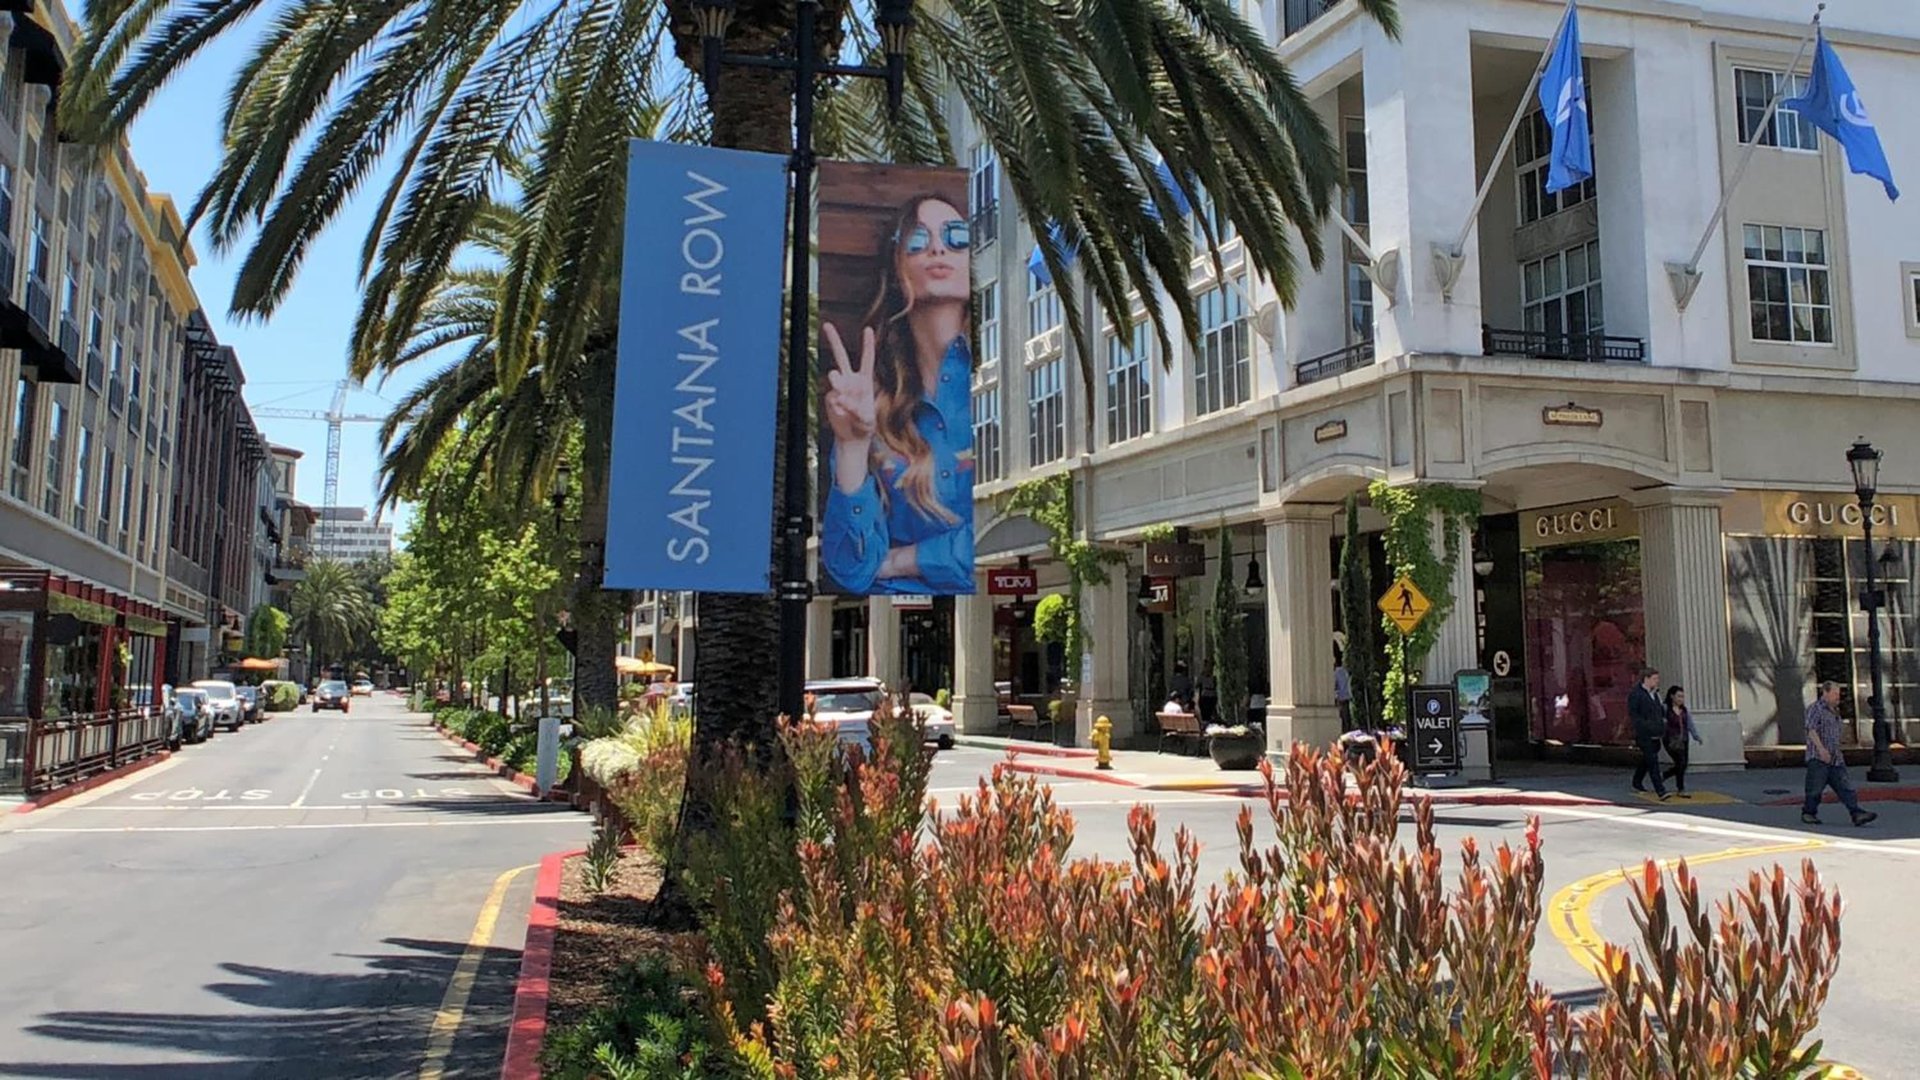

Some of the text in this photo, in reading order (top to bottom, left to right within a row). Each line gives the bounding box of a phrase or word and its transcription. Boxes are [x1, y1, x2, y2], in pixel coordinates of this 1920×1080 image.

[667, 170, 729, 565] SANTANA ROW
[1536, 508, 1612, 537] GUCCI
[1790, 502, 1899, 527] GUCCI
[1416, 717, 1451, 729] VALET
[129, 787, 273, 801] STOP
